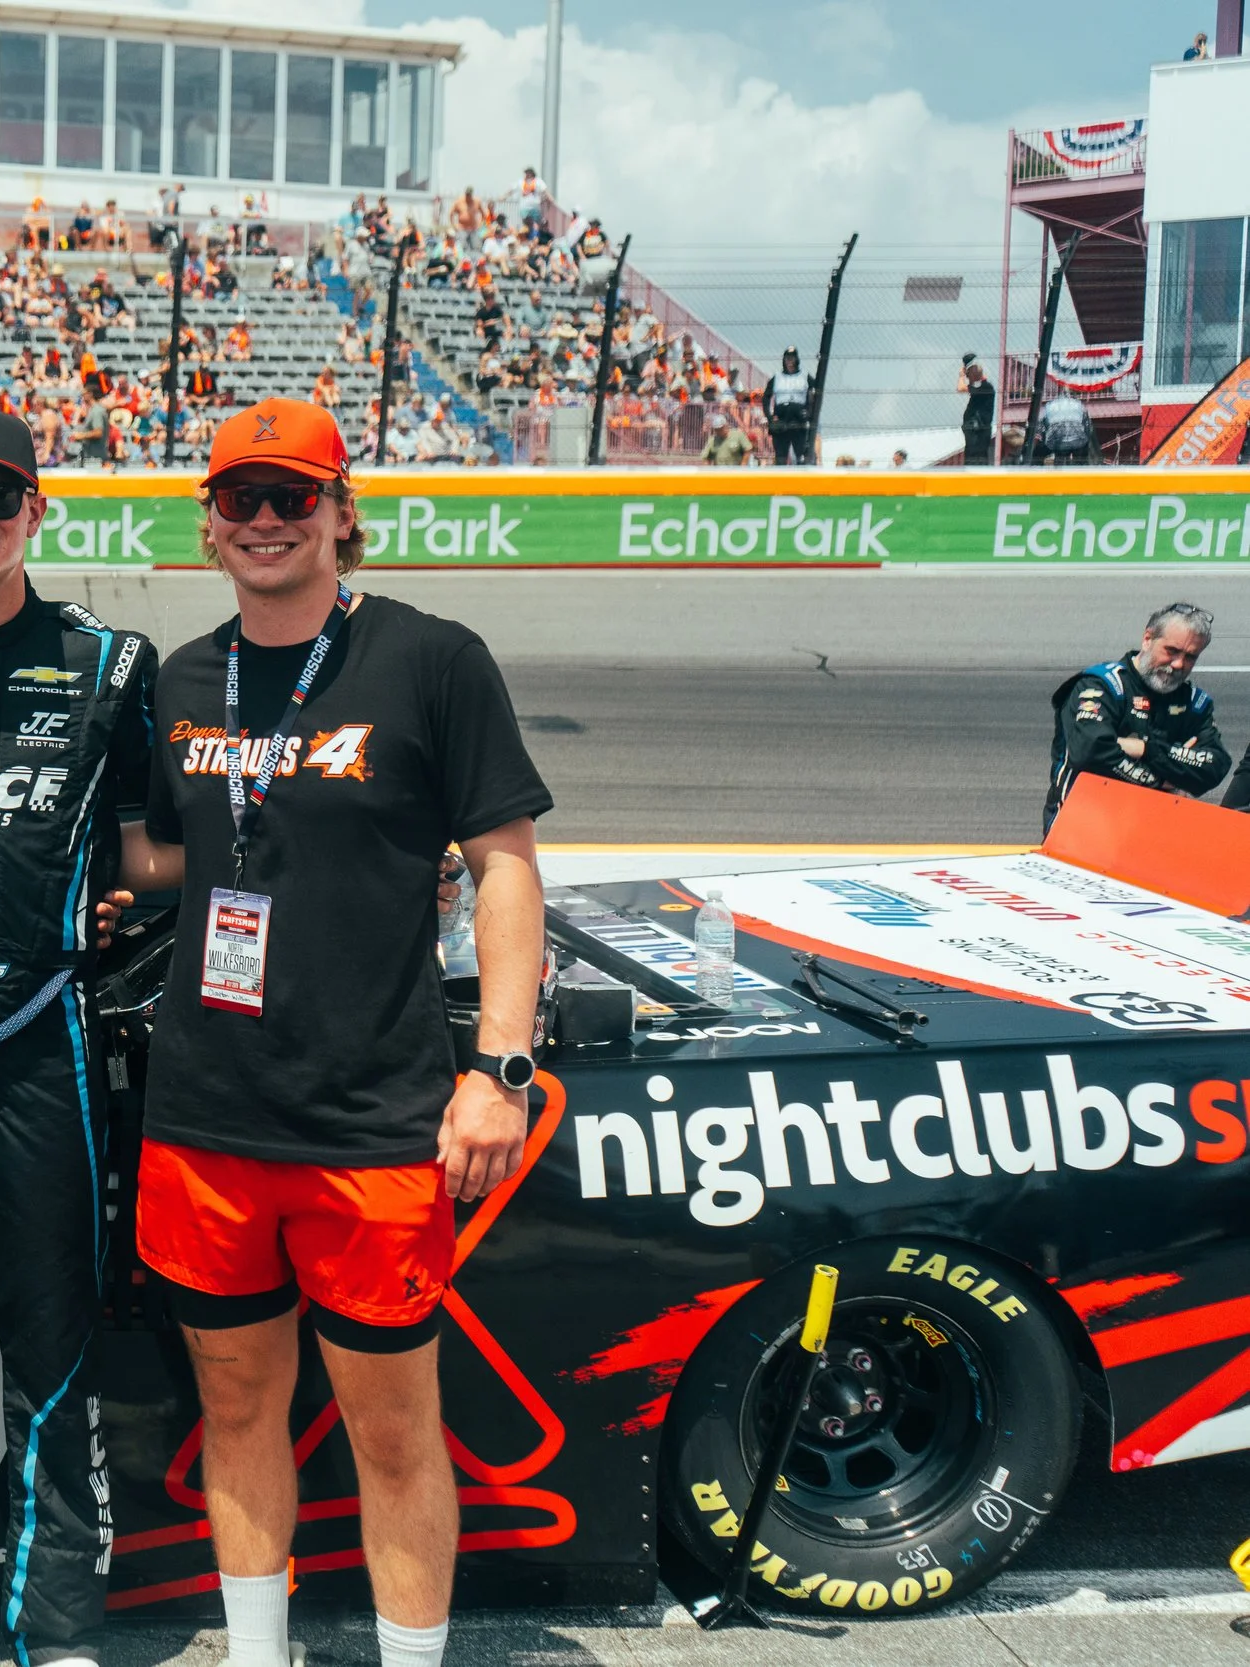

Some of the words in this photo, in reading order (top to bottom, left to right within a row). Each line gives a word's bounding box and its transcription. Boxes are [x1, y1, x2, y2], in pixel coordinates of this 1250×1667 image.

[619, 496, 892, 559] EchoPark
[110, 636, 141, 689] sparco
[225, 655, 239, 706] NASCAR
[298, 633, 332, 690] NASCAR
[7, 685, 83, 696] CHEVROLET
[16, 740, 66, 749] ELECTRIC
[255, 733, 287, 790] NASCAR
[302, 723, 374, 779] 4
[228, 752, 246, 806] NASCAR
[912, 870, 1082, 921] UTILITRA
[208, 949, 261, 975] WILKESBORO
[939, 937, 1067, 984] SOLUTIONS
[978, 936, 1089, 975] STAFFING
[885, 1246, 1029, 1324] EAGLE
[691, 1479, 954, 1611] GOODYAR
